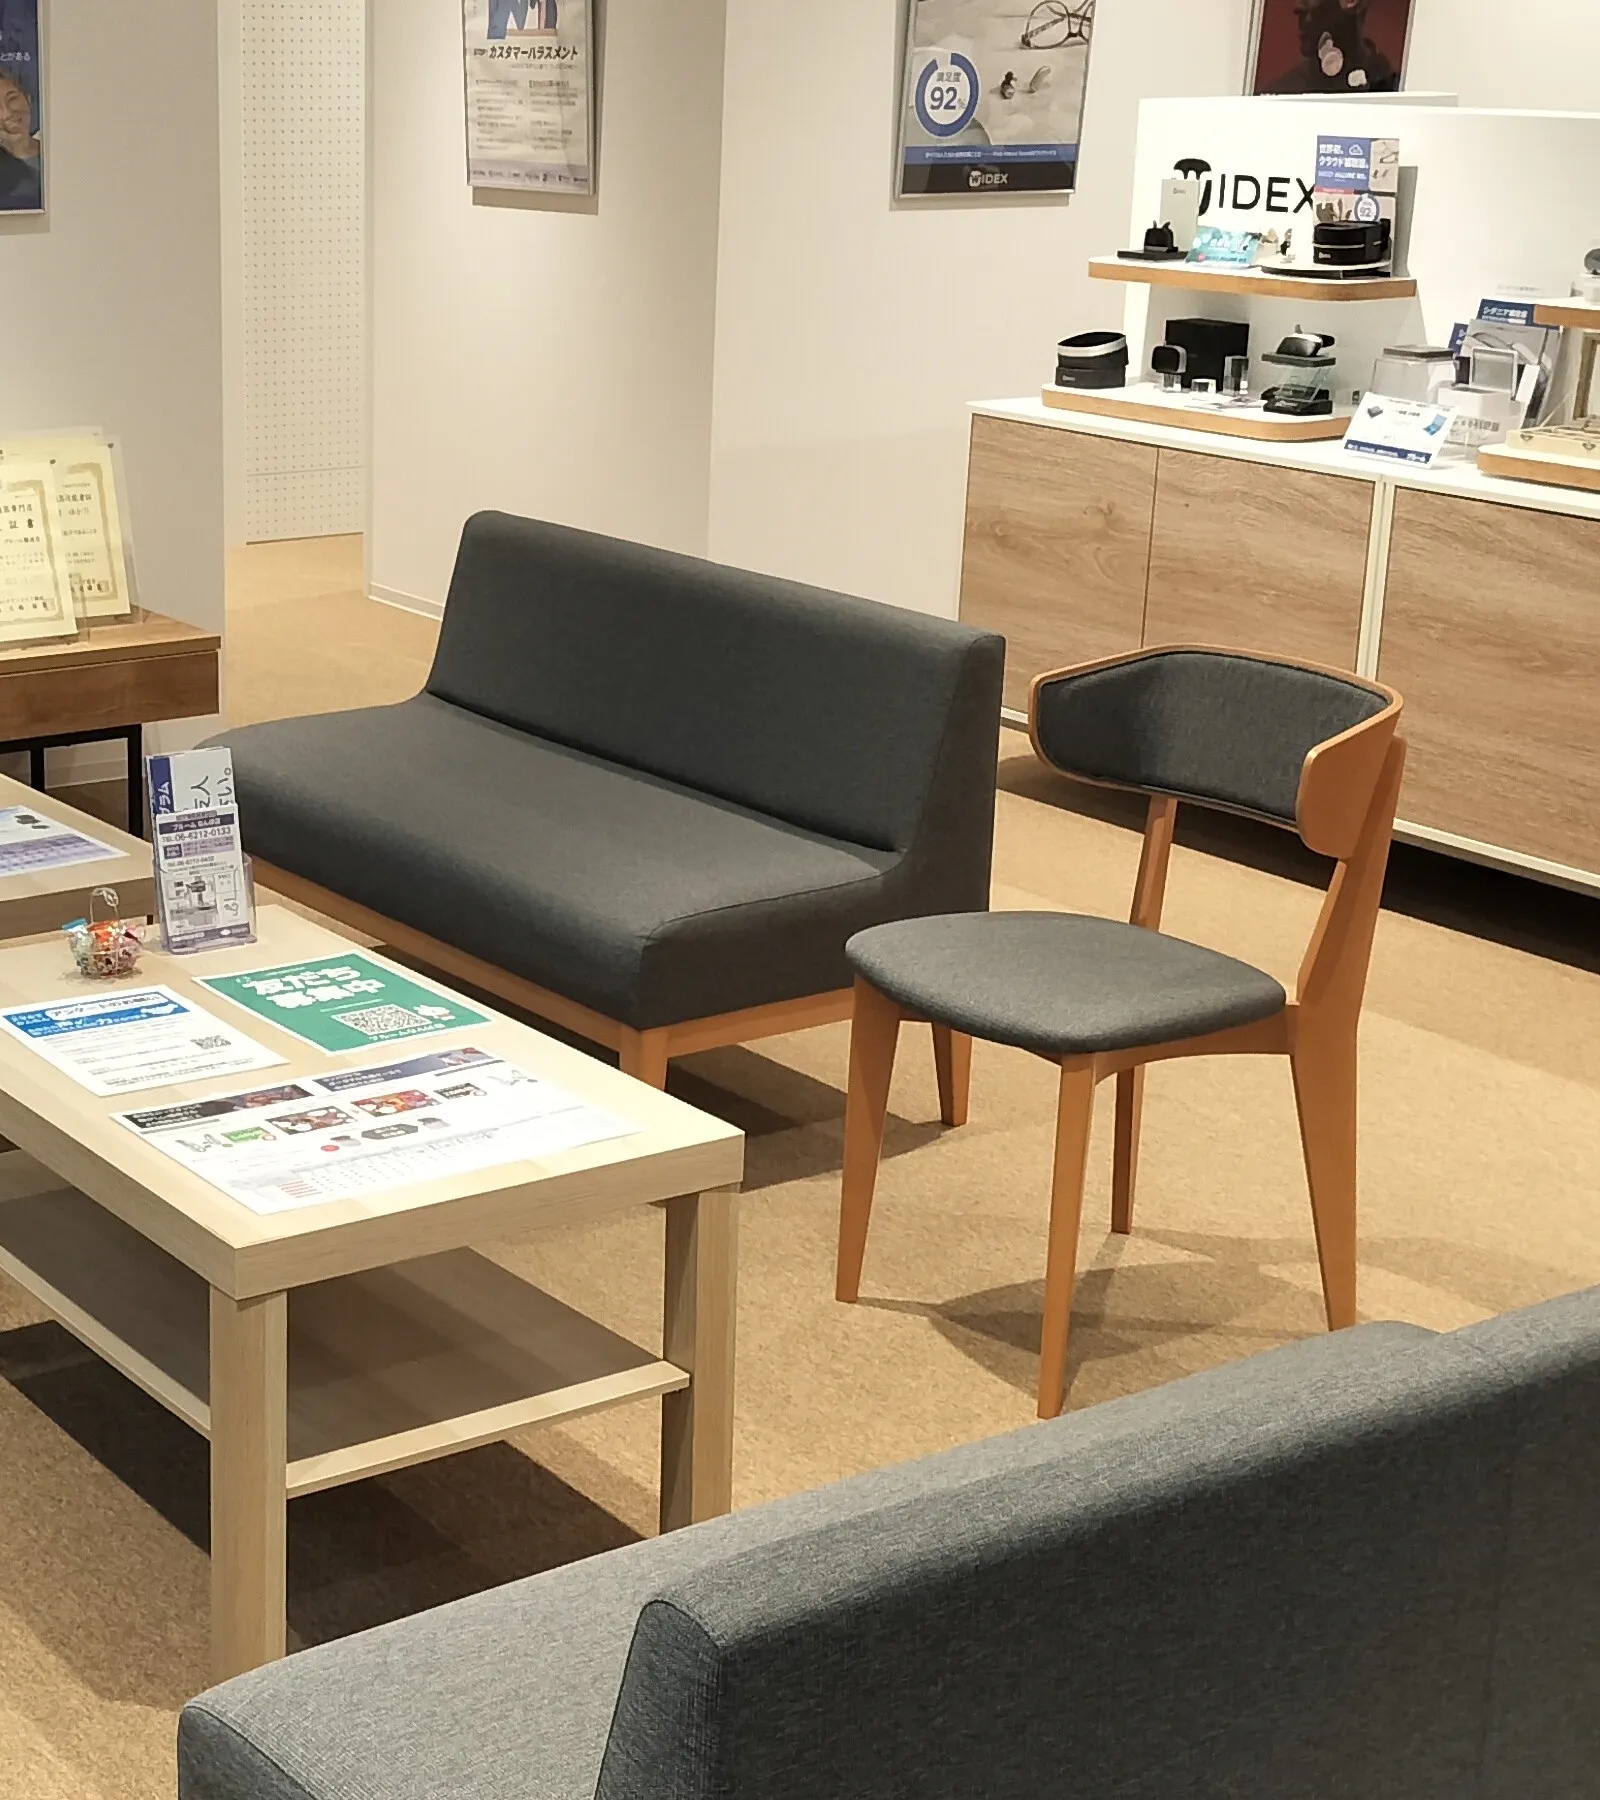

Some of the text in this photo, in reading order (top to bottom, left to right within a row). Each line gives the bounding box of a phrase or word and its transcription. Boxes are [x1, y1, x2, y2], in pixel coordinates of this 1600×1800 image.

[489, 45, 578, 60] カスタマーハラスメント
[242, 966, 361, 996] 友だち
